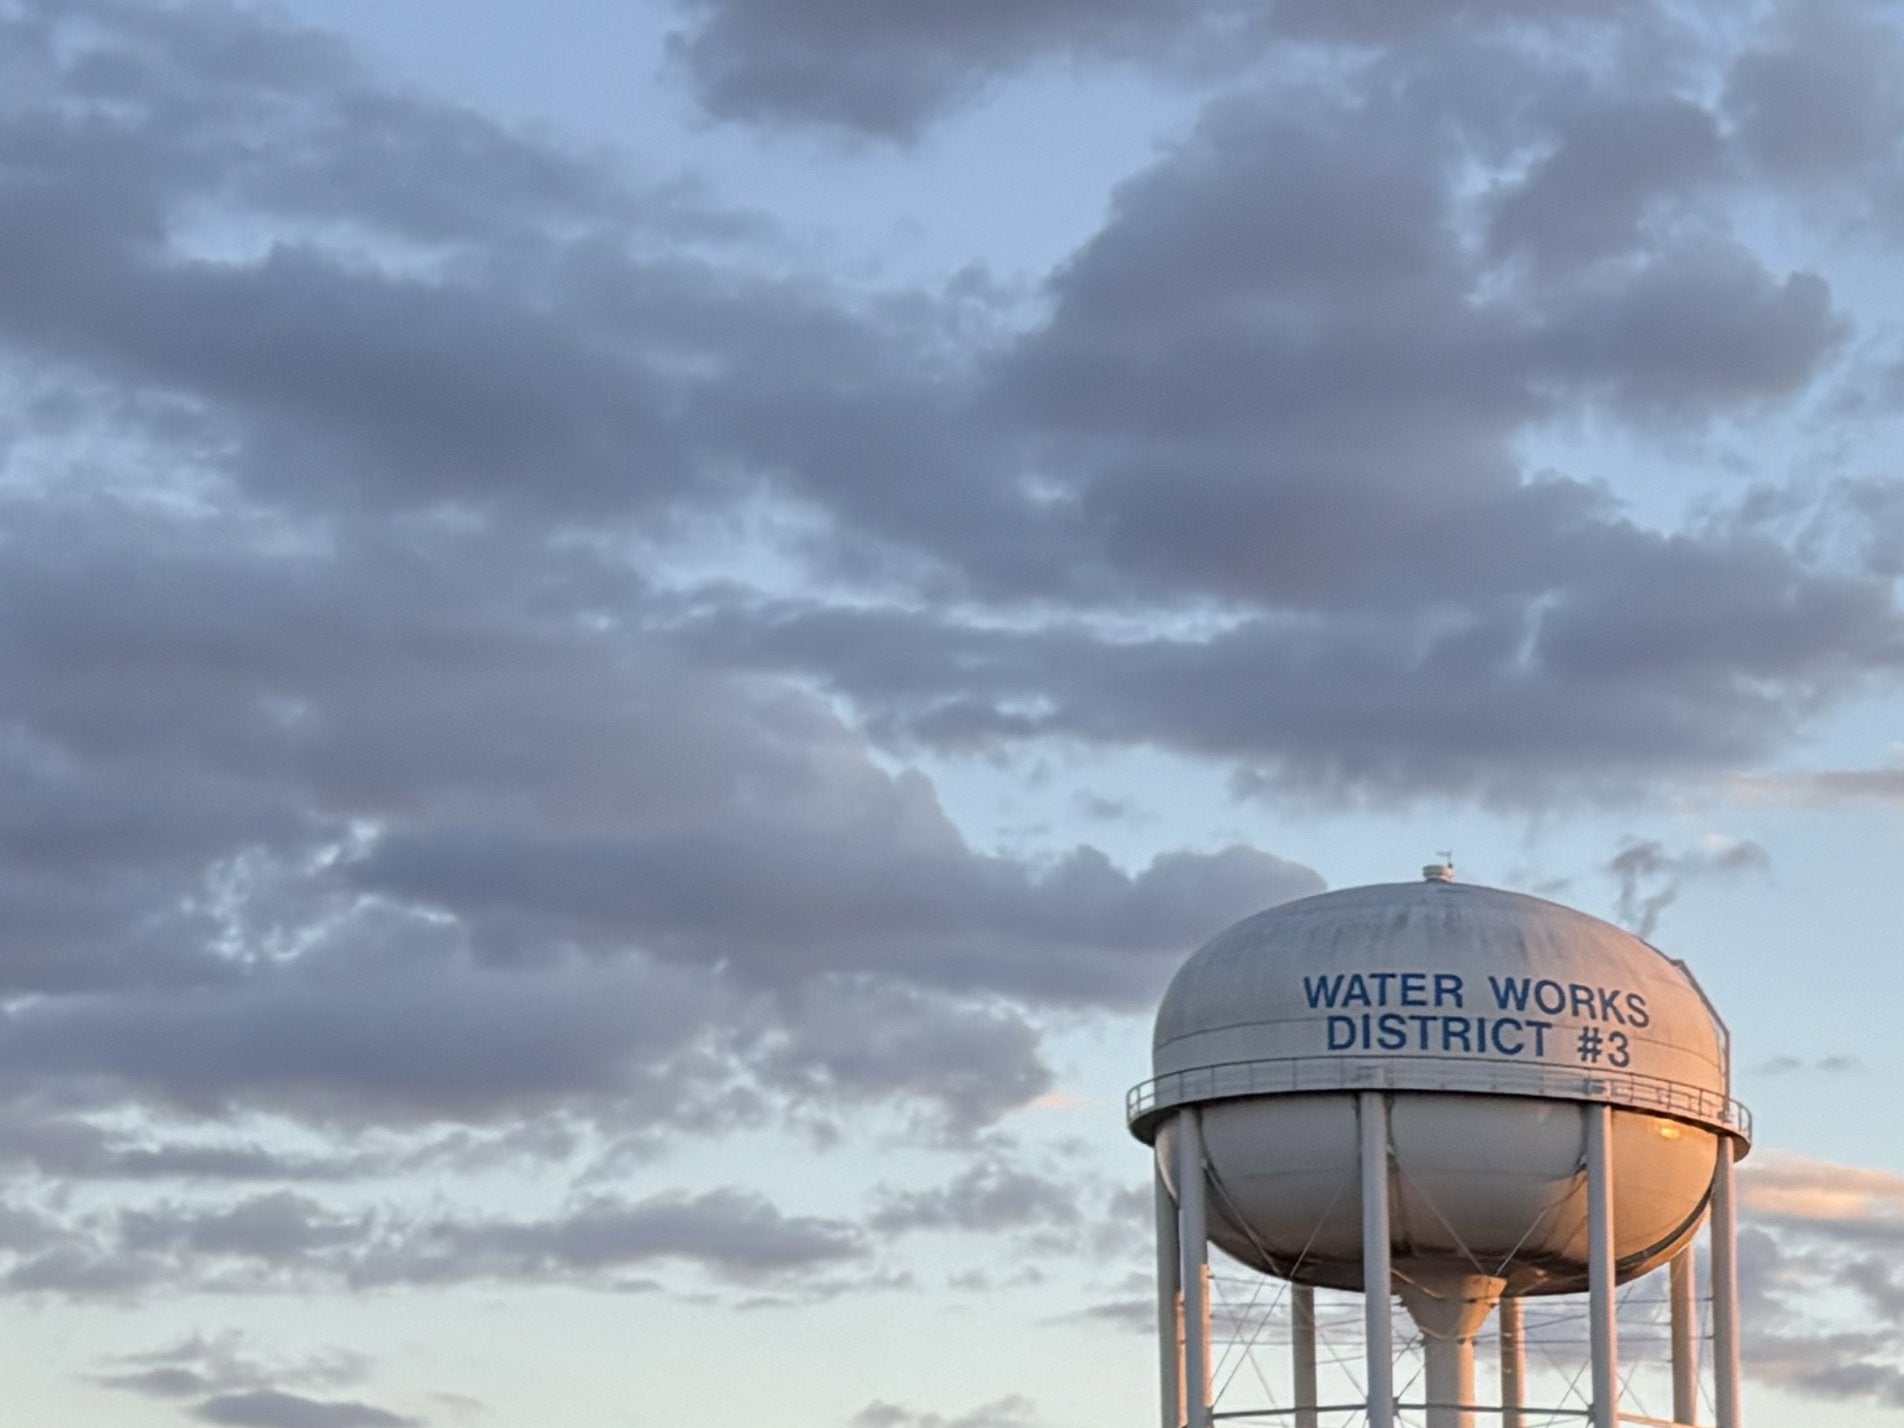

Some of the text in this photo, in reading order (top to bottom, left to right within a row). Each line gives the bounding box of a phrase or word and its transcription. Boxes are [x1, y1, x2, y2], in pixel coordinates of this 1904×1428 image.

[1302, 972, 1650, 1028] WATER WORKS
[1326, 1013, 1631, 1069] DISTRICT #3
